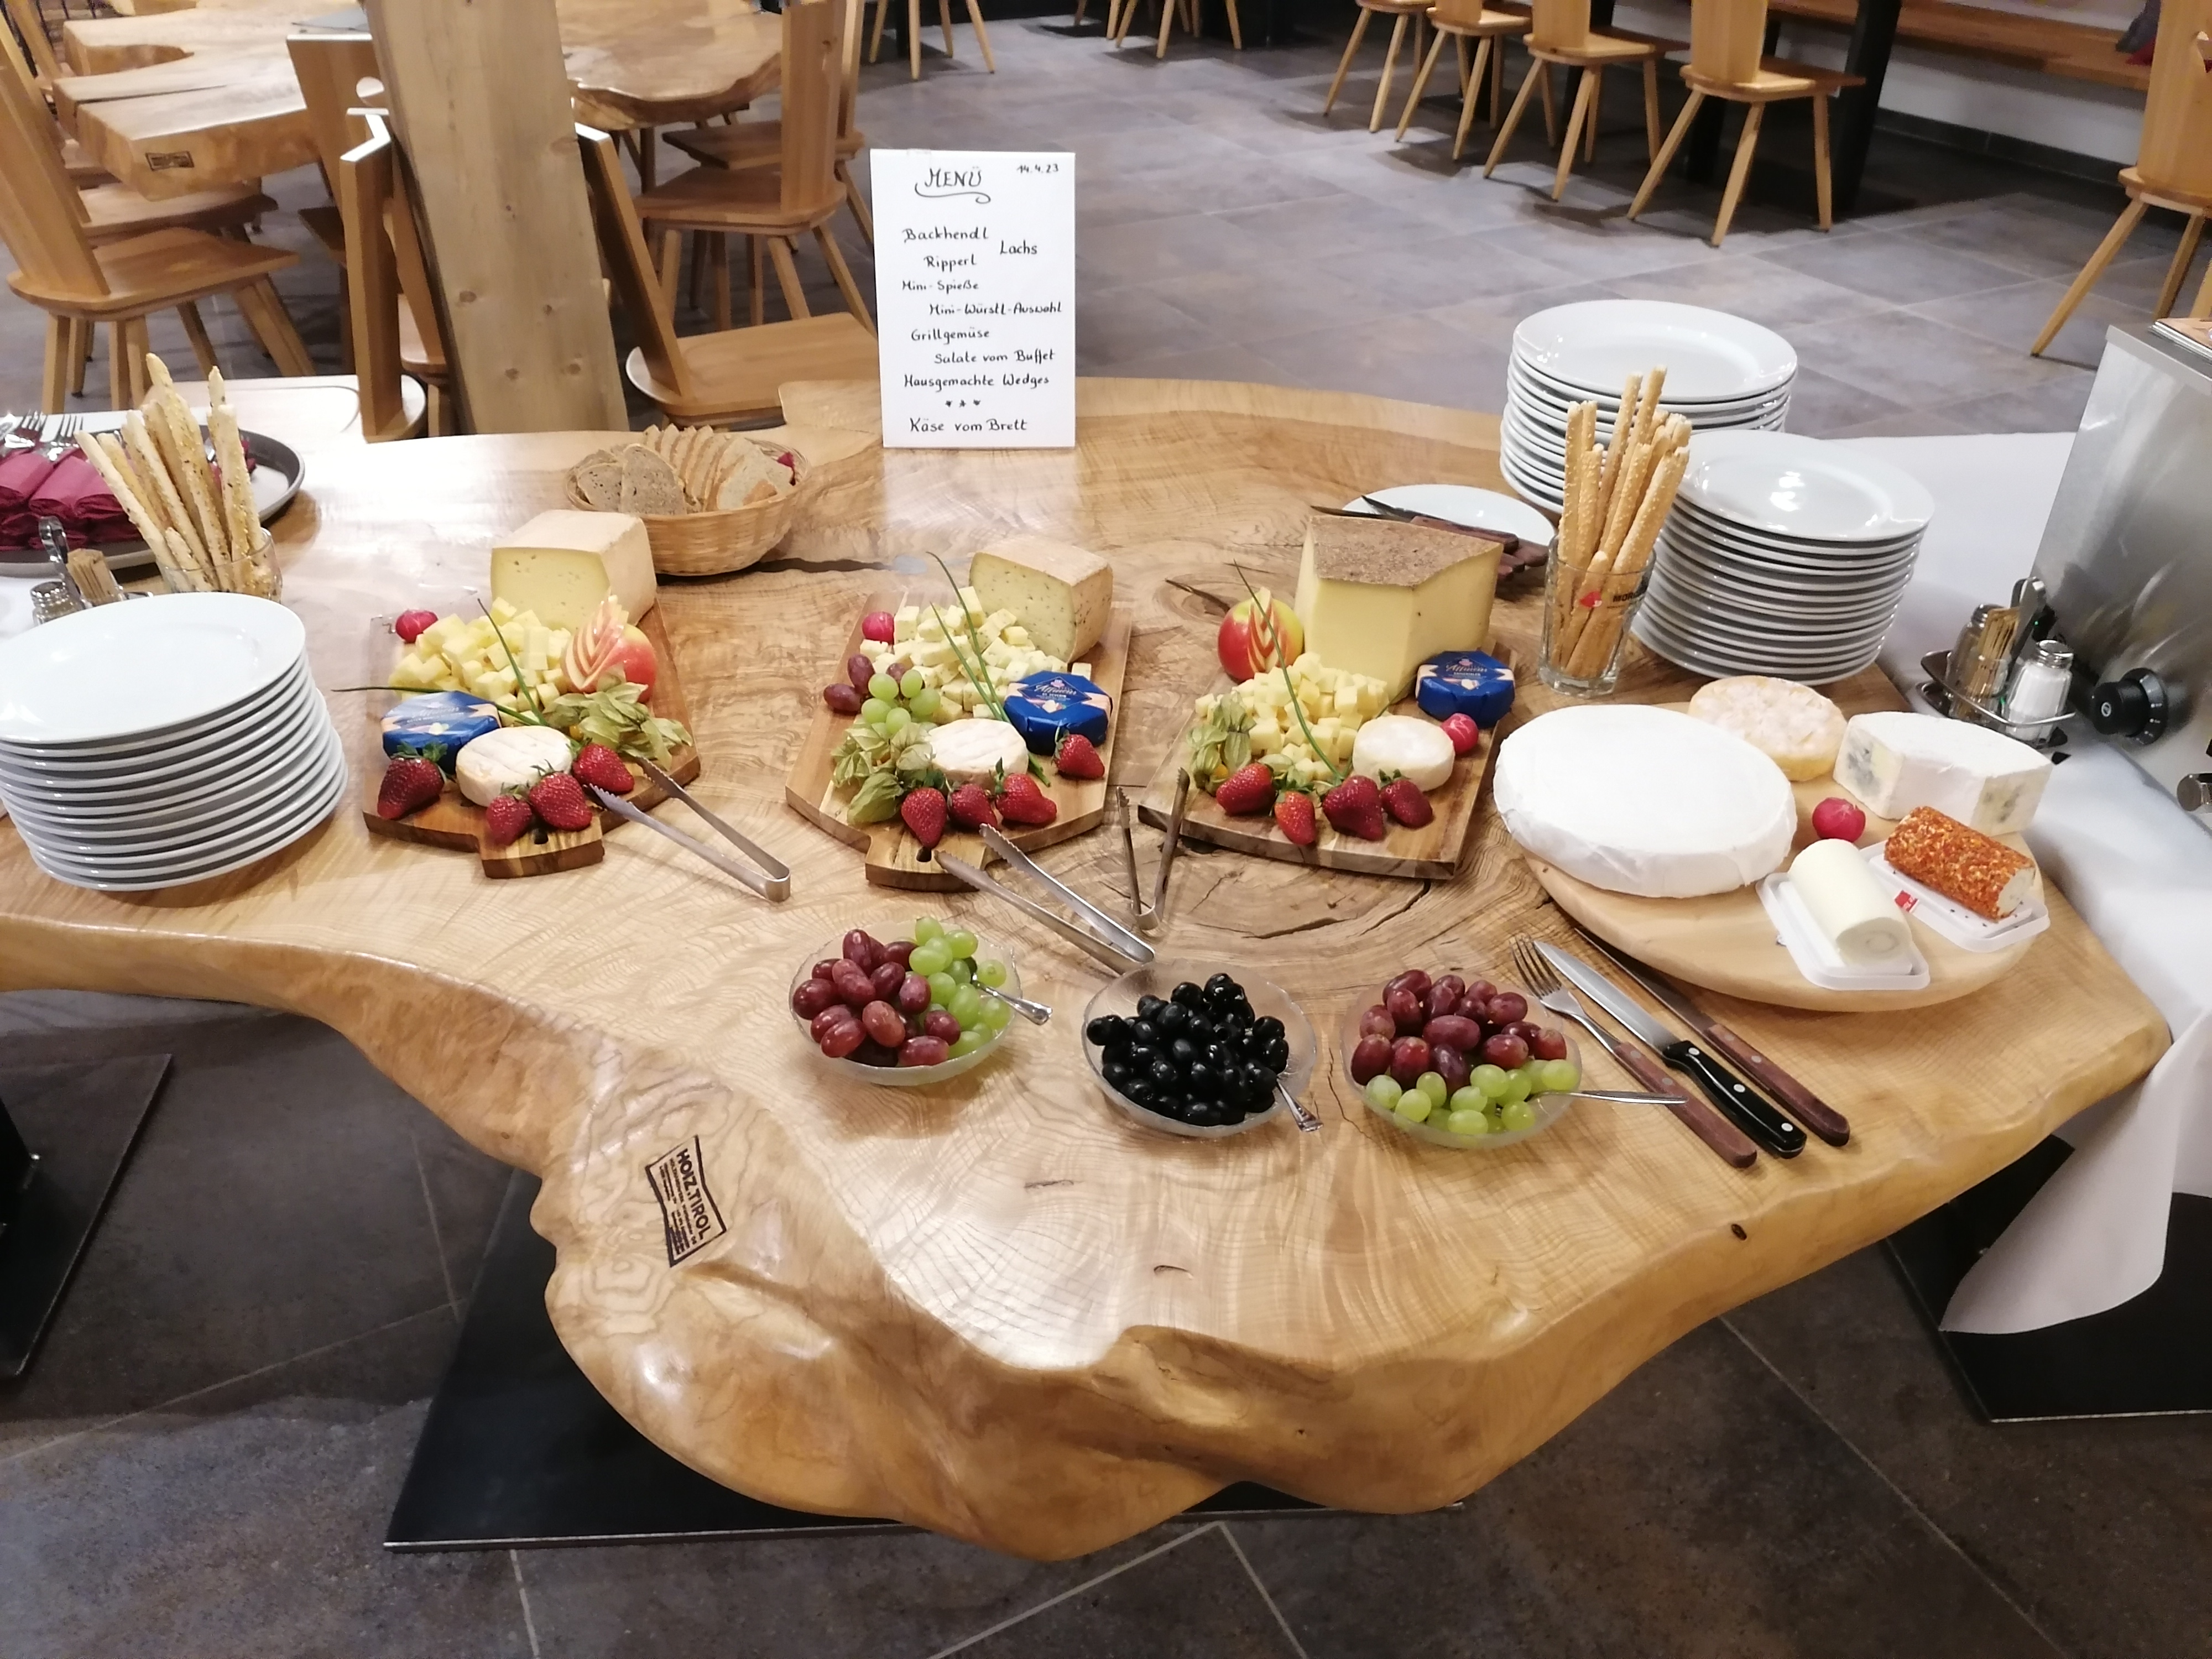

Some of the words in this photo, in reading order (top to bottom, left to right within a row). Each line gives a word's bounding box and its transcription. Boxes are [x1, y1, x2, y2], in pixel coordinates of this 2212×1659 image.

[924, 165, 982, 188] MENÜ
[1016, 163, 1059, 174] 14.4.23
[901, 225, 989, 244] Backhendl
[999, 238, 1038, 255] Lachs
[923, 252, 977, 273] Ripperl
[910, 326, 990, 346] Grillgemüse
[933, 350, 977, 364] Salate
[982, 354, 1009, 363] vom
[1013, 347, 1056, 366] Buffet
[904, 373, 995, 393] Hausgemachte
[1002, 372, 1050, 390] Wedges
[909, 416, 945, 433] Käse
[954, 422, 983, 432] vom
[985, 418, 1028, 431] Brett
